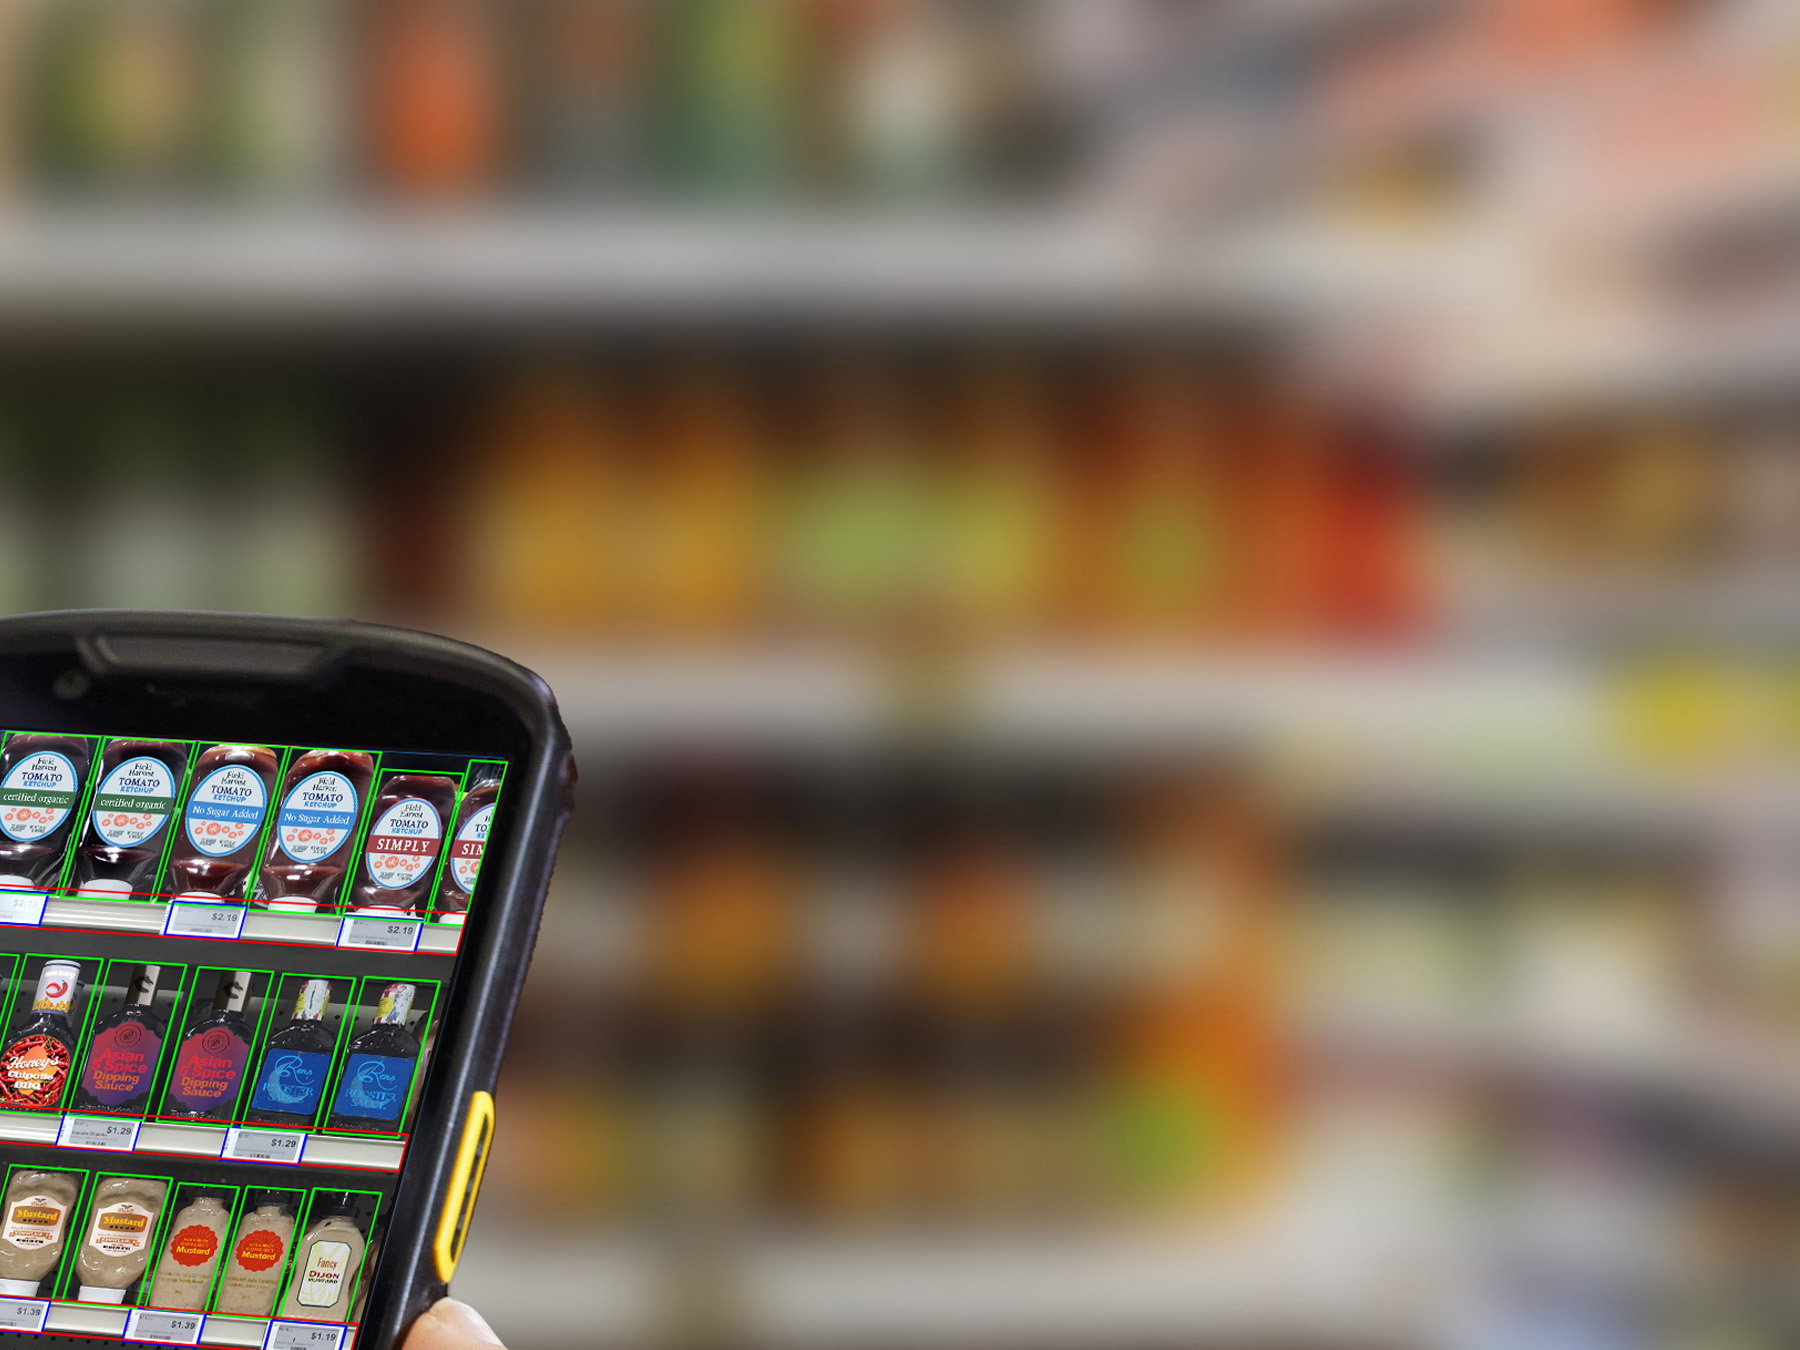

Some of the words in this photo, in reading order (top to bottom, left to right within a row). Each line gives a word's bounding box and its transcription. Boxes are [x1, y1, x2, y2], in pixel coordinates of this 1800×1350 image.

[22, 772, 63, 782] TOMATO
[119, 777, 160, 787] TOMATO
[23, 780, 57, 788] KETCHUP
[120, 786, 154, 794] KETCHUP
[211, 785, 252, 797] TOMATO
[3, 793, 36, 802] certified
[38, 796, 70, 805] organic
[213, 794, 246, 803] KETCHUP
[303, 792, 343, 802] TOMATO
[100, 798, 133, 808] certified
[135, 801, 166, 811] organic
[304, 801, 337, 809] KETCHUP
[192, 806, 205, 814] No
[207, 807, 229, 817] Sugar
[231, 809, 258, 820] Added
[284, 813, 296, 821] No
[298, 814, 320, 824] Sugar
[323, 816, 350, 825] Added
[390, 819, 429, 829] TOMATO
[391, 827, 423, 835] KETCHUP
[475, 824, 489, 833] TO
[376, 838, 430, 853] SIMPLY
[211, 912, 238, 922] $2.19
[387, 924, 414, 935] $2.19
[99, 1048, 144, 1062] Asian
[7, 1053, 60, 1070] Honey's
[91, 1058, 100, 1070] 5
[104, 1059, 148, 1074] Spice
[187, 1054, 232, 1068] Asian
[8, 1071, 53, 1080] Chipotle
[179, 1064, 188, 1076] 5
[192, 1065, 236, 1080] Spice
[93, 1071, 140, 1085] Dipping
[14, 1081, 40, 1090] BBQ
[95, 1080, 134, 1092] Sauce
[181, 1077, 228, 1091] Dipping
[182, 1086, 222, 1098] Sauce
[262, 1082, 313, 1097] ROOSTER
[345, 1088, 396, 1102] ROOSTER
[106, 1126, 132, 1136] $1.29
[271, 1138, 297, 1148] $1.29
[16, 1210, 58, 1220] Mustard
[104, 1217, 145, 1227] Mustard
[176, 1246, 210, 1255] Mustard
[242, 1251, 276, 1260] Mustard
[317, 1257, 338, 1270] Fancy
[309, 1270, 340, 1279] DIJON
[16, 1307, 42, 1317] $1.39
[171, 1320, 196, 1330] $1.39
[311, 1332, 337, 1342] $1.19
